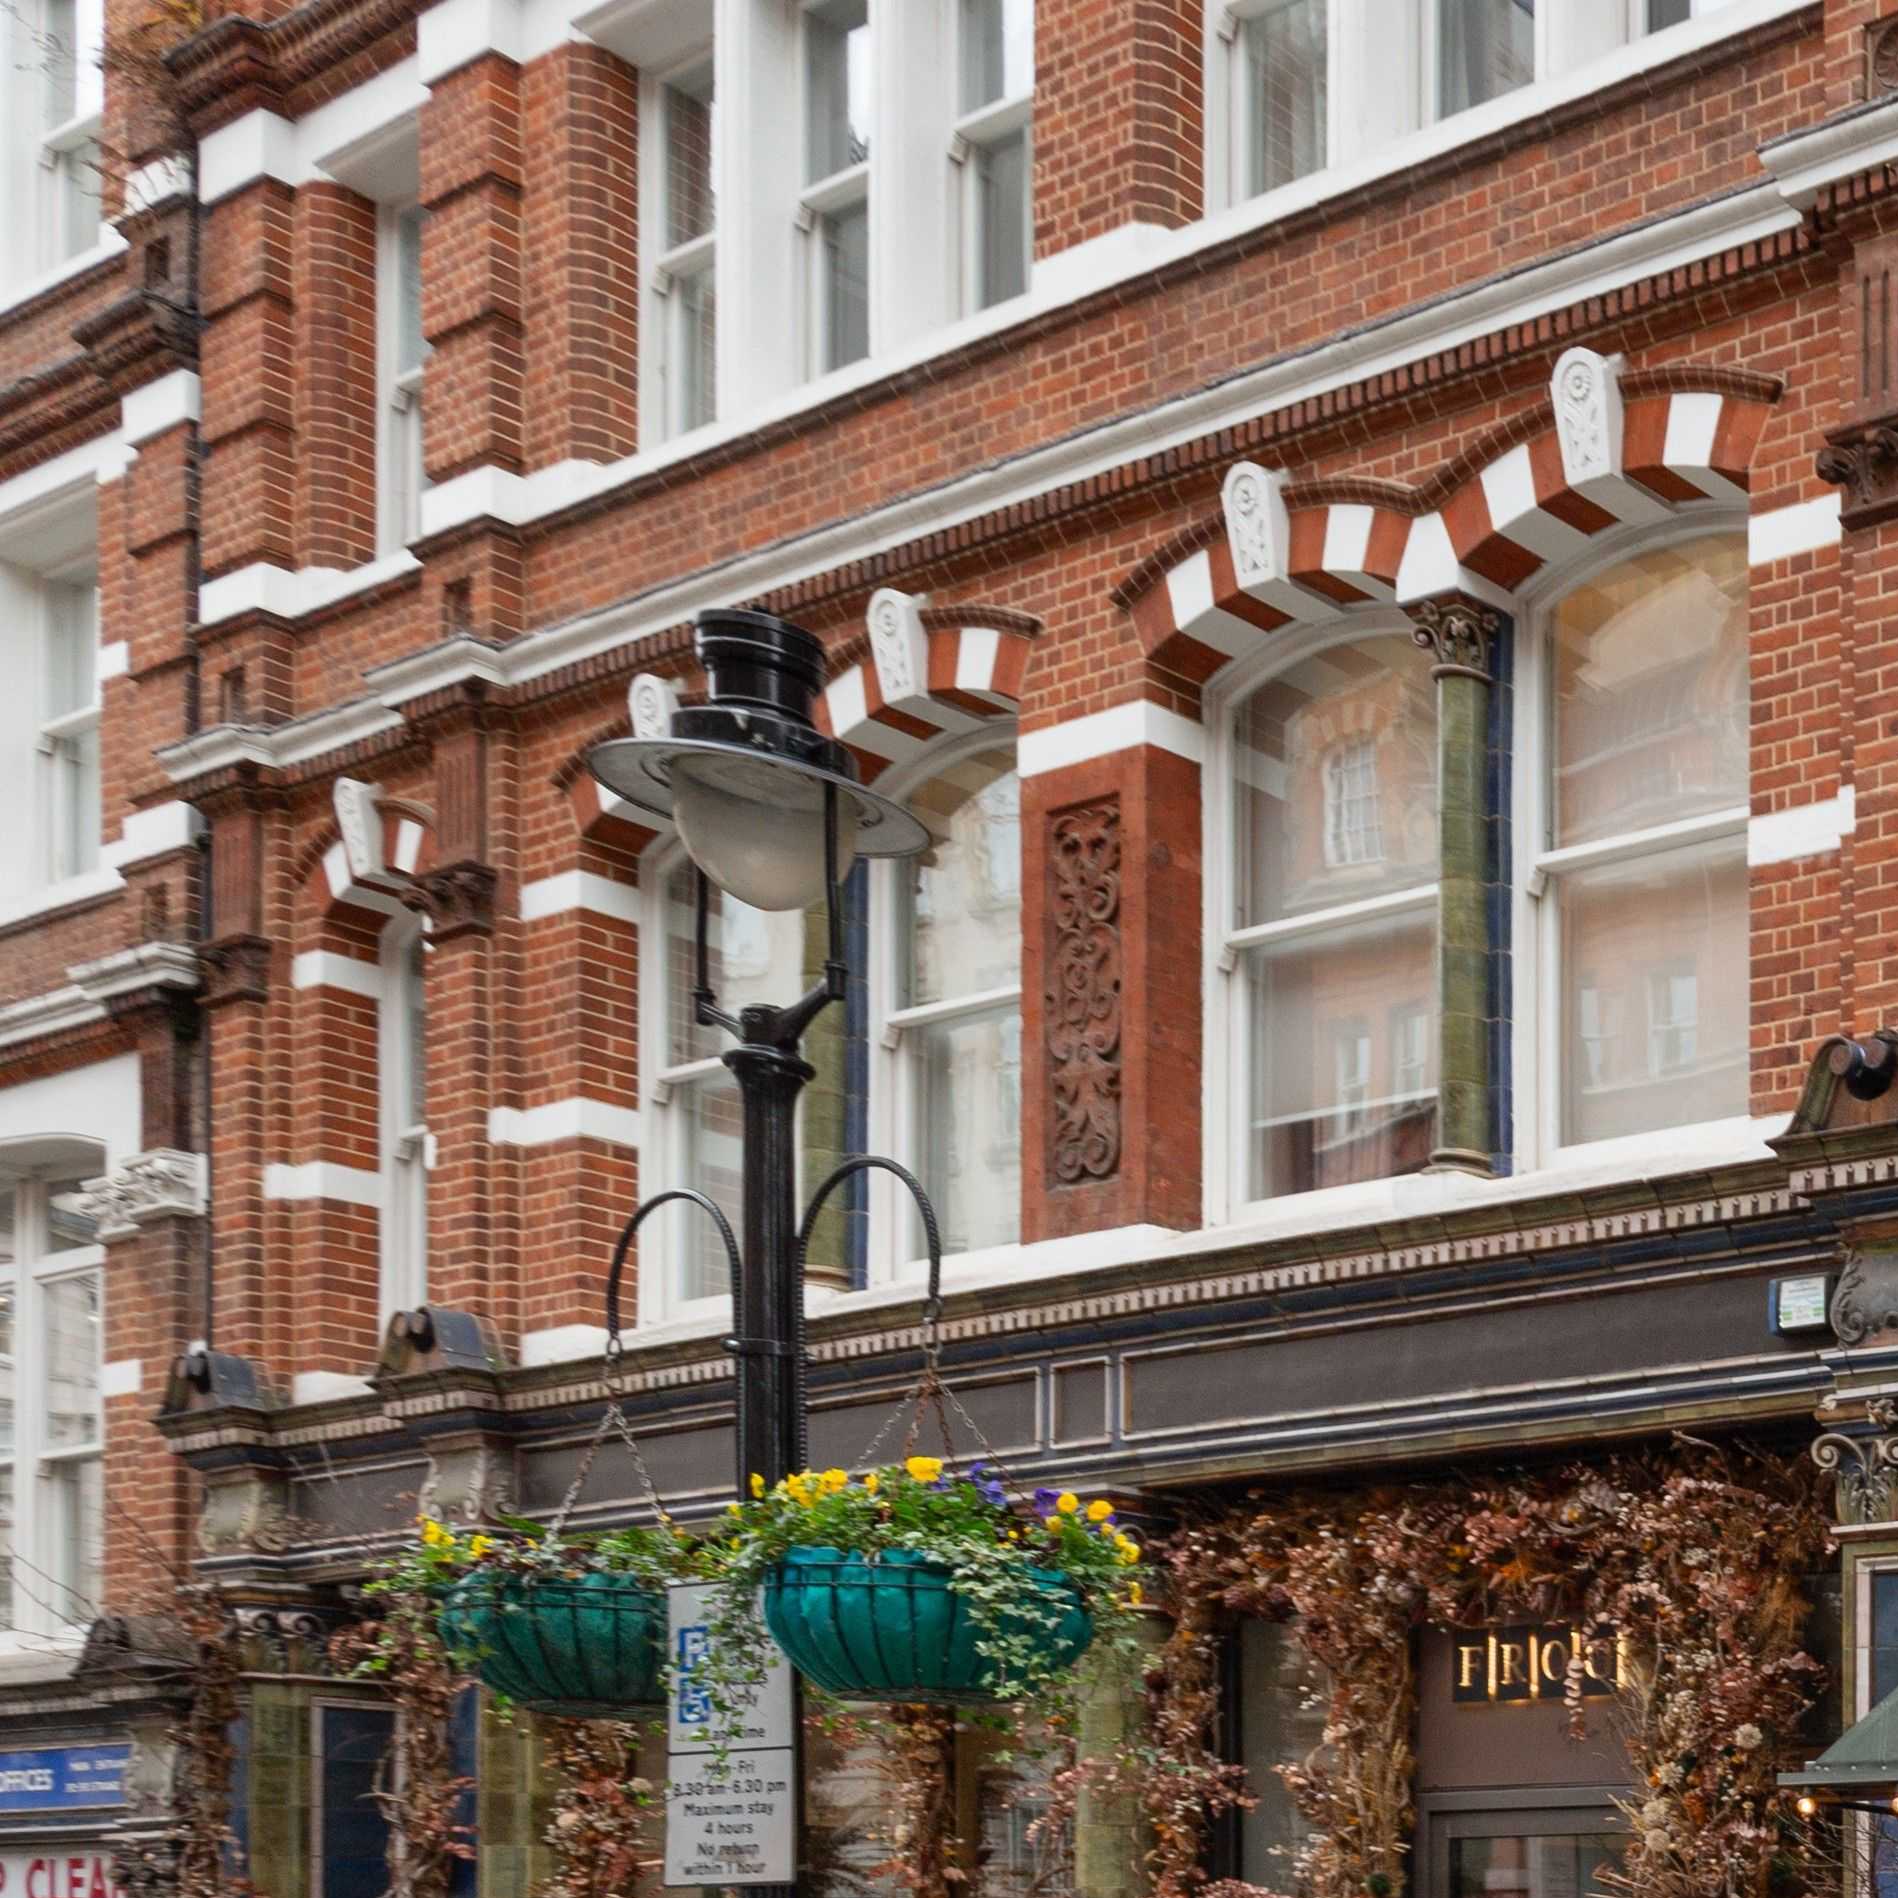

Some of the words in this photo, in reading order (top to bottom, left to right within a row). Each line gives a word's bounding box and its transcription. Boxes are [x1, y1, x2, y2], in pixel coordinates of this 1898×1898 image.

[683, 1803, 743, 1816] Maximum
[747, 1801, 775, 1816] stay
[704, 1822, 713, 1834] 4
[717, 1822, 754, 1834] hours
[697, 1843, 715, 1855] No
[736, 1862, 766, 1874] hour
